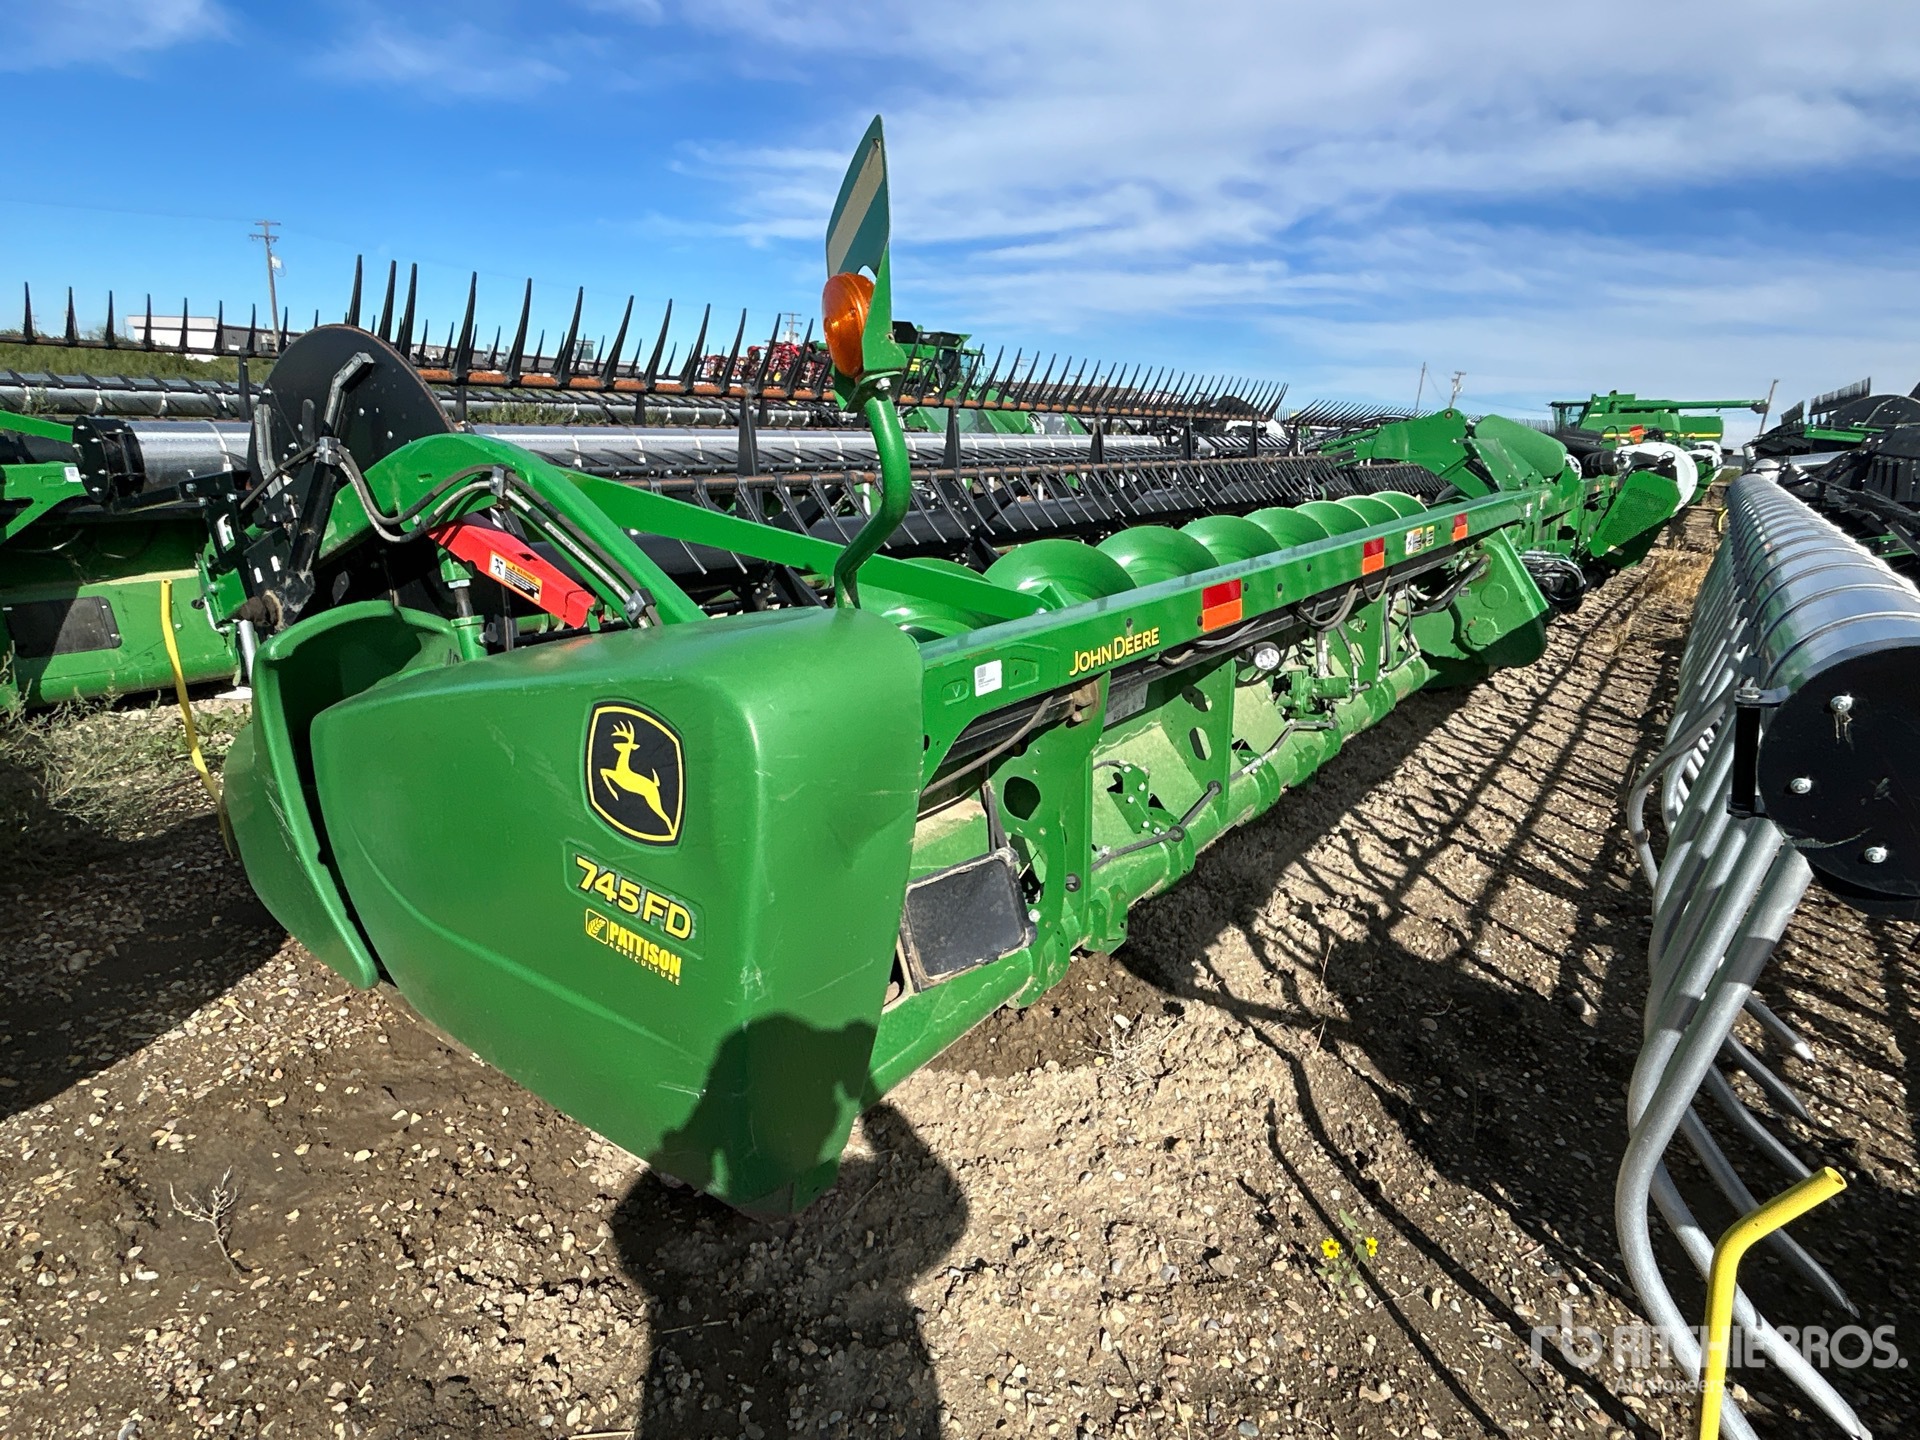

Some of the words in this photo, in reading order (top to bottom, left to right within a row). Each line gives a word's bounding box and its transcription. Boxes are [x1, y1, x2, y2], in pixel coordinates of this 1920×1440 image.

[1069, 643, 1112, 676] JOHN
[1114, 627, 1160, 660] DEERE
[575, 856, 693, 940] 745FD
[609, 921, 681, 978] PATTISON
[609, 941, 680, 986] AGRICULTURE
